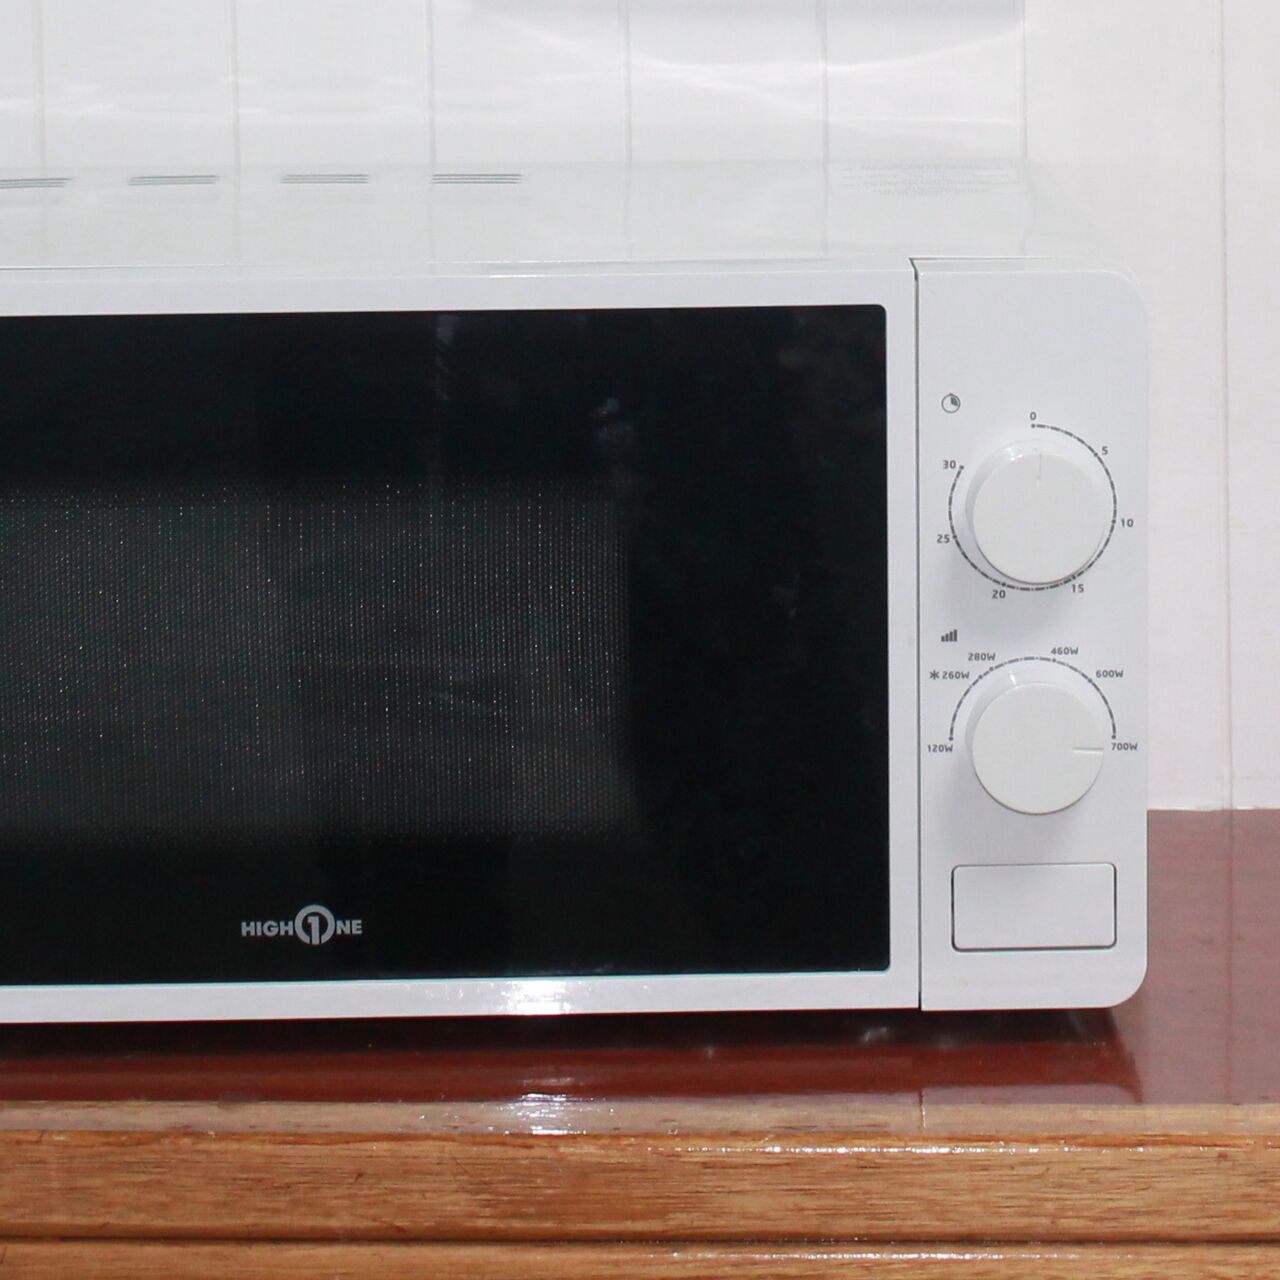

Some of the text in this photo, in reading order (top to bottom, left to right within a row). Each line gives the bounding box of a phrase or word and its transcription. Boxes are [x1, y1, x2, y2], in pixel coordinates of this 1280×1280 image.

[1101, 446, 1109, 456] 5
[943, 459, 957, 470] 30
[1120, 518, 1134, 528] 10
[936, 534, 951, 544] 25
[992, 589, 1006, 600] 20
[1072, 584, 1084, 594] 15
[1050, 646, 1079, 657] 460W
[968, 652, 996, 663] 280W
[1095, 668, 1124, 679] 600W
[927, 743, 954, 754] 120W
[1111, 742, 1138, 752] 700W
